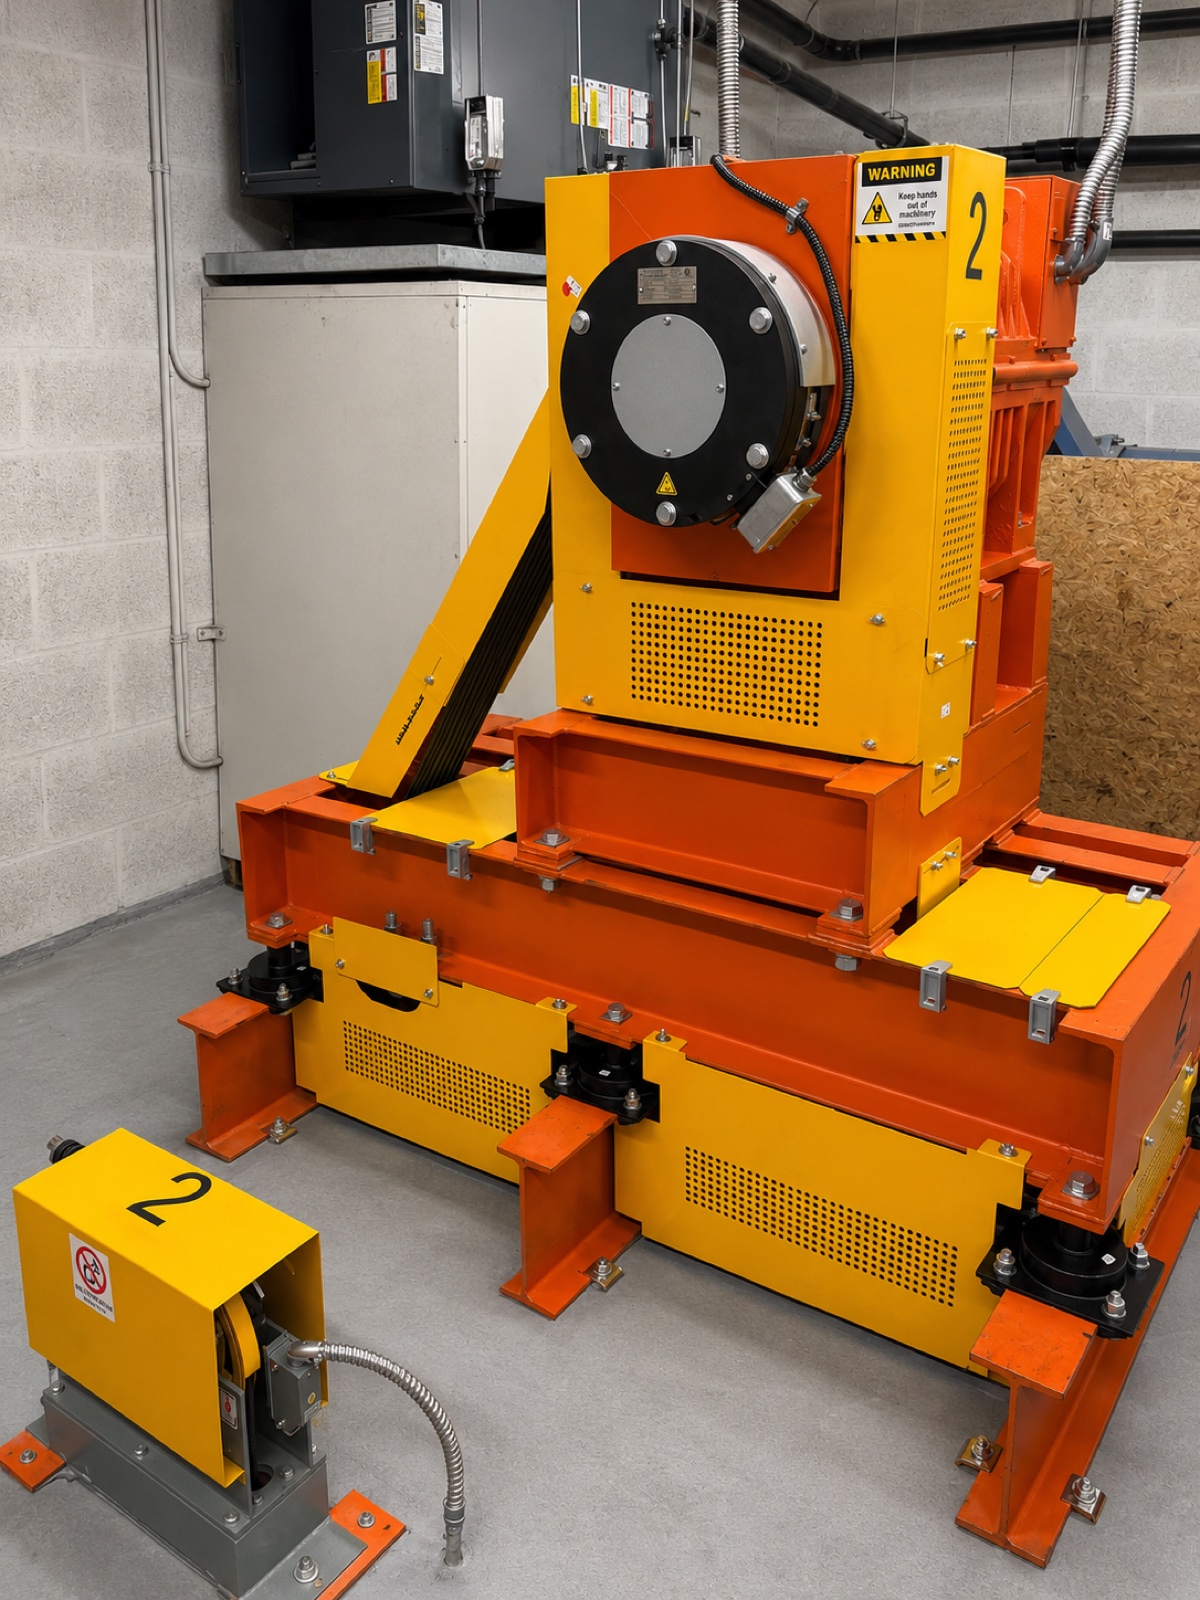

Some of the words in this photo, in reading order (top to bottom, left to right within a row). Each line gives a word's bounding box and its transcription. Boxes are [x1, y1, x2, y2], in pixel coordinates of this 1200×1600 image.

[868, 163, 936, 181] WARNING
[898, 192, 916, 201] Keep
[917, 190, 937, 199] hands
[920, 200, 928, 208] of
[899, 209, 936, 219] machinery
[965, 191, 987, 280] 2
[1174, 971, 1191, 1046] 2
[126, 1172, 212, 1227] 2
